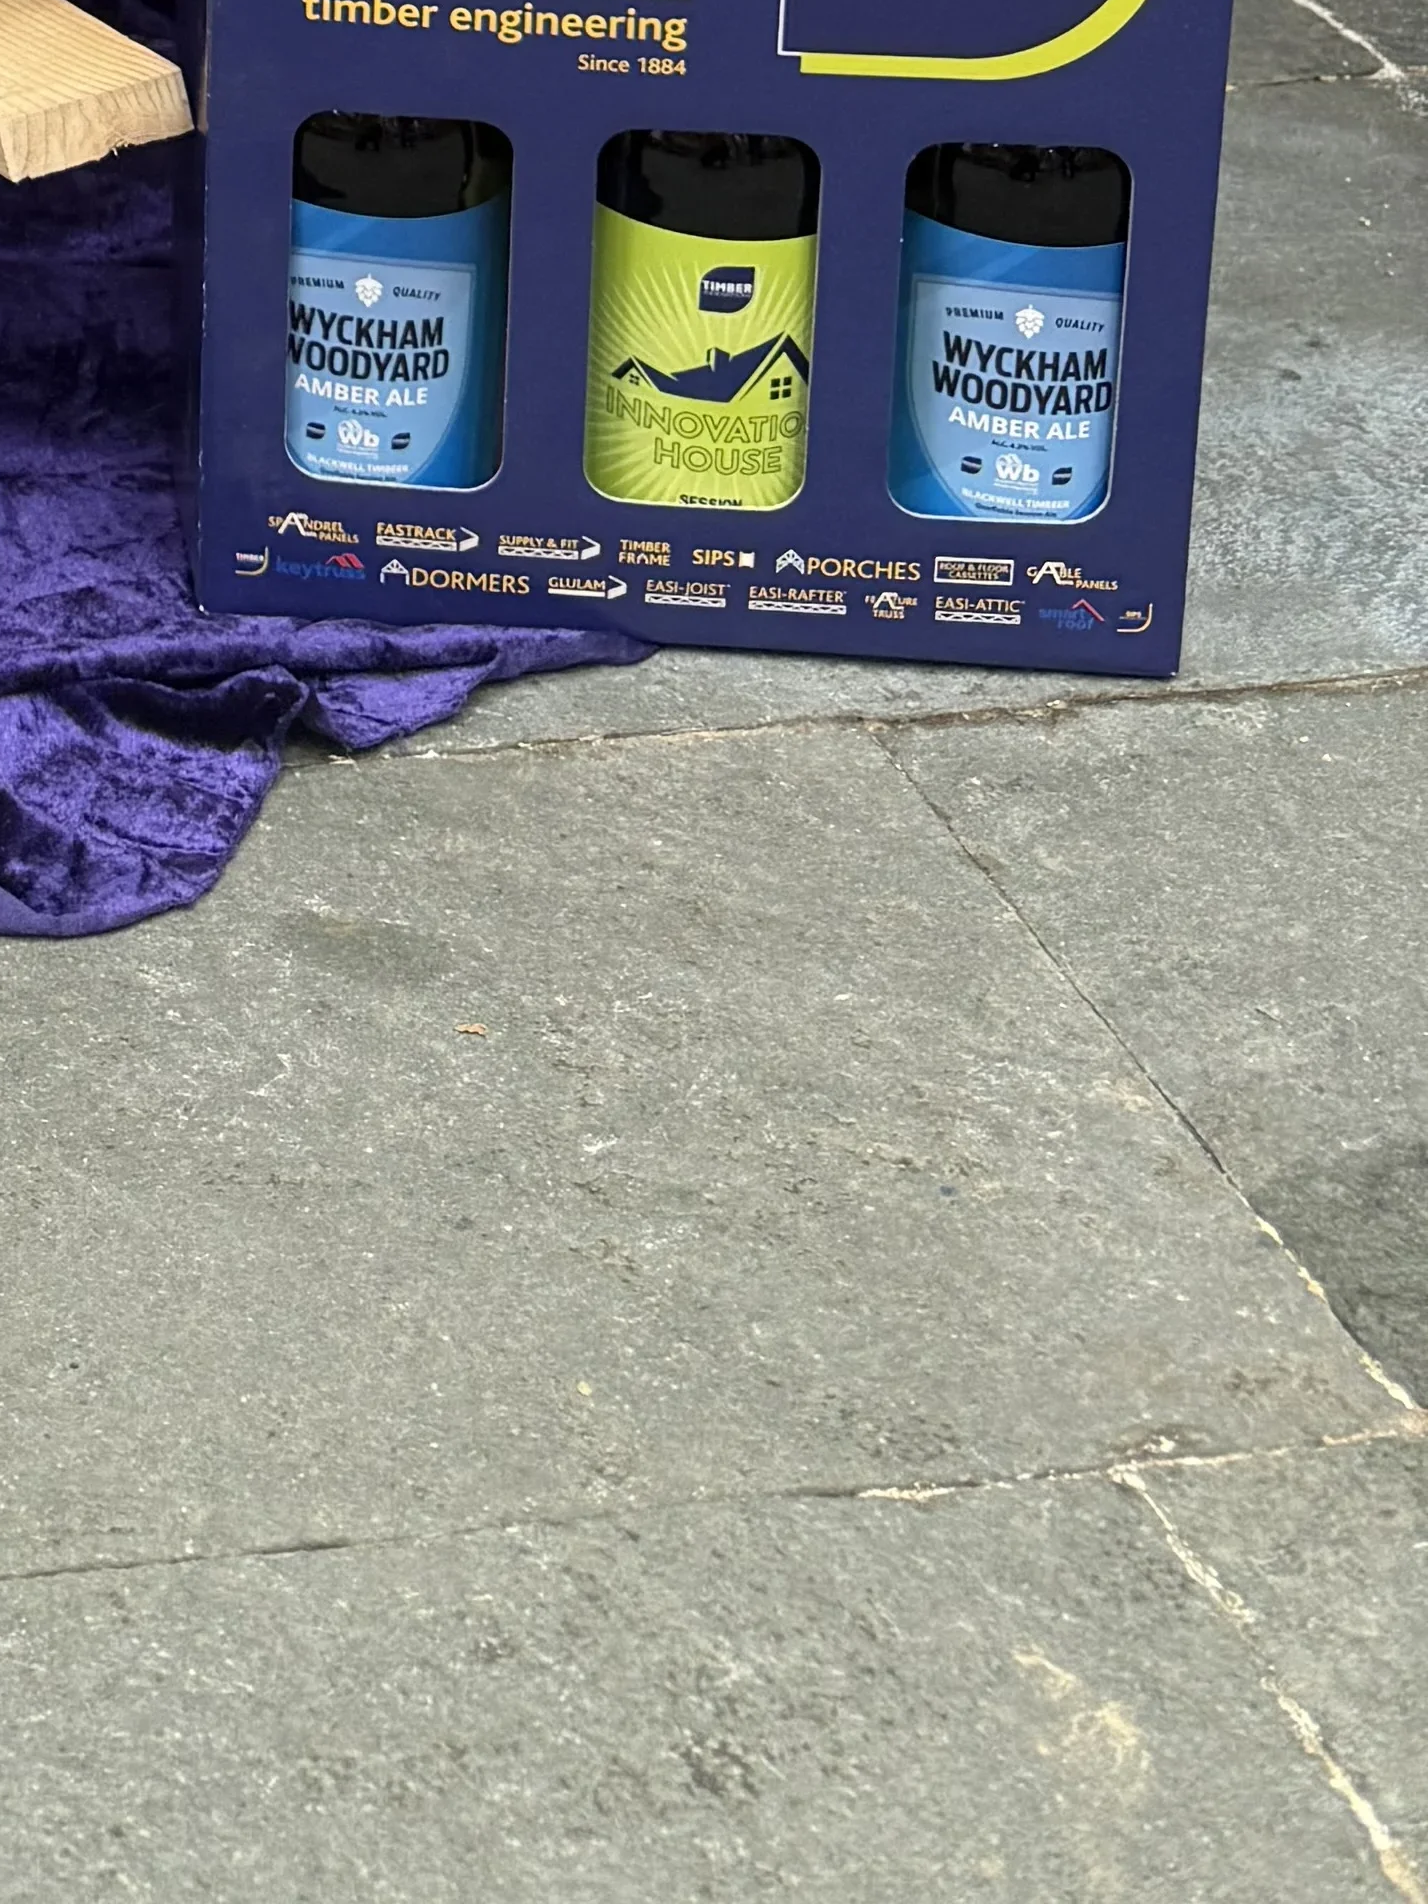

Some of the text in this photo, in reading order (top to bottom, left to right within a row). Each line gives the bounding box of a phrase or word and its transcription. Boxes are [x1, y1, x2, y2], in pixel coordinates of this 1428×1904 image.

[448, 0, 688, 51] engineering
[576, 53, 687, 76] Since 1884
[392, 286, 442, 302] QUALITY
[701, 279, 753, 295] TIMBER
[288, 298, 445, 350] WYCKHAM
[946, 306, 1106, 333] PREMIUM QUALITY
[943, 331, 1108, 382] WYCKHAM
[294, 373, 429, 407] AMBER ALE
[931, 359, 1114, 416] WOODYARD
[948, 406, 1092, 441] AMBER ALE
[654, 437, 783, 476] HOUSE
[376, 522, 456, 542] FASTRACK
[619, 539, 671, 553] TIMBER
[692, 548, 736, 567] SIPS
[618, 552, 671, 567] FRAME
[806, 557, 921, 582] PORCHES
[411, 567, 531, 595] DORMERS
[548, 576, 606, 591] GLULAM
[645, 579, 725, 597] EASI-JOIST
[748, 585, 845, 604] EASI-RAFTER
[935, 596, 1021, 613] EASI-ATTIC
